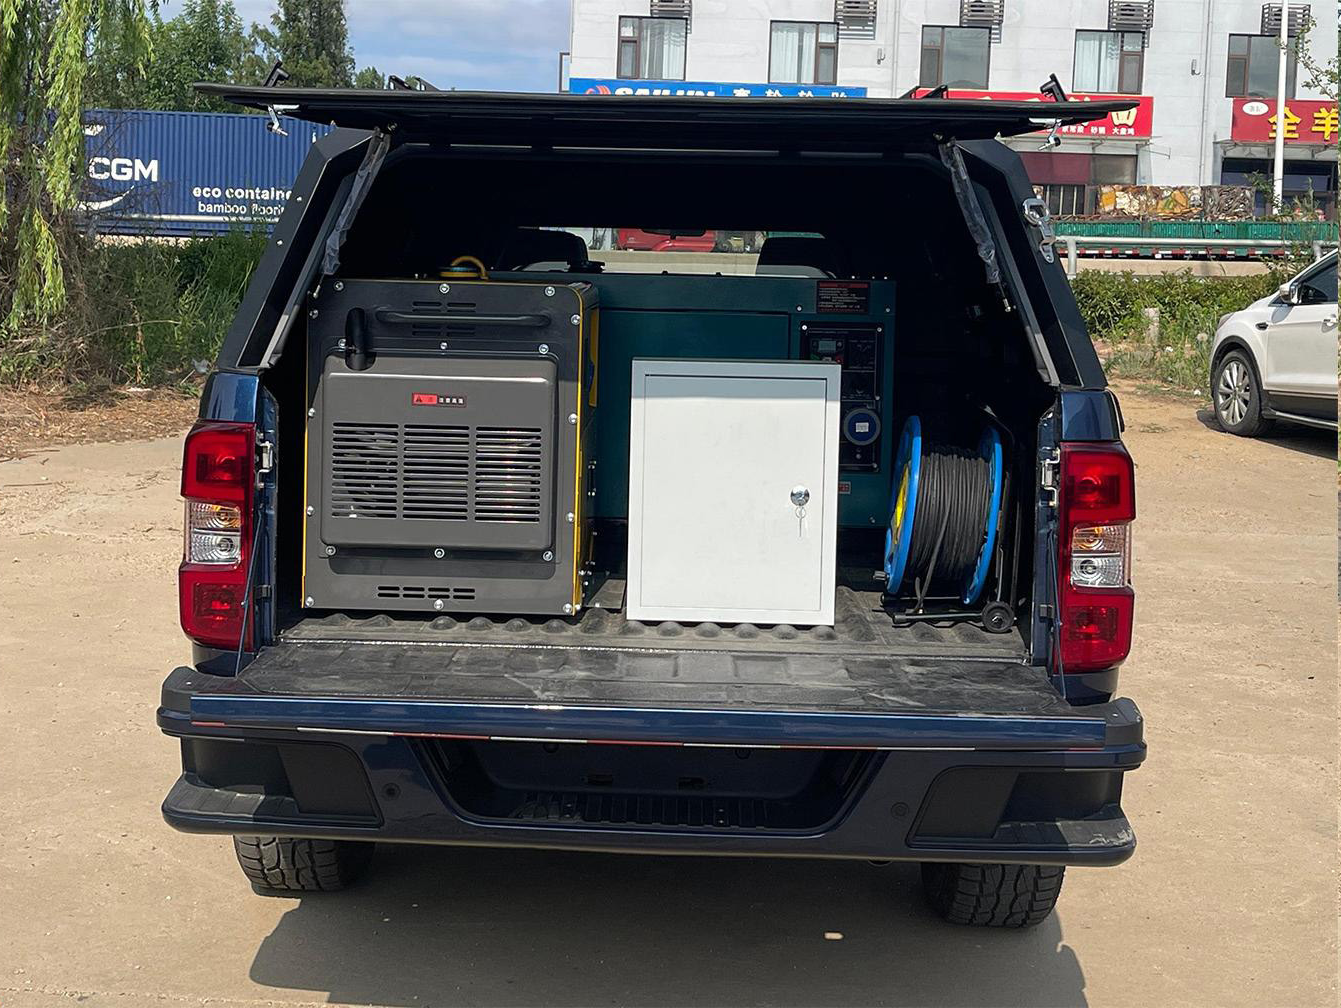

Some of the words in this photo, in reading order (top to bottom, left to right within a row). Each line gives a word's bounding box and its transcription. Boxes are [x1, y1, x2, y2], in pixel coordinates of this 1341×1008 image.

[88, 157, 158, 182] CGM
[192, 187, 222, 198] eco
[198, 201, 247, 214] bamboo
